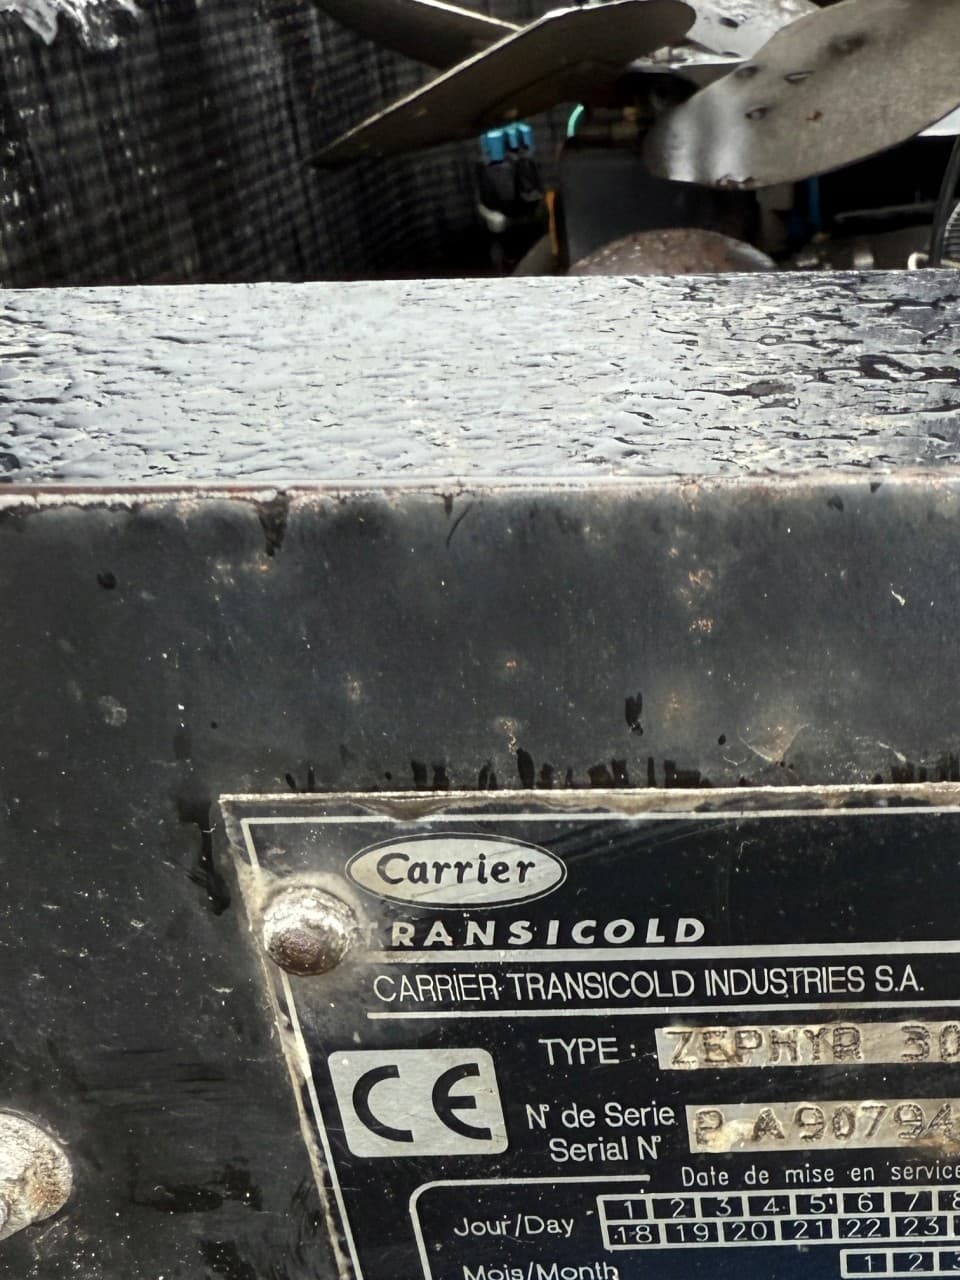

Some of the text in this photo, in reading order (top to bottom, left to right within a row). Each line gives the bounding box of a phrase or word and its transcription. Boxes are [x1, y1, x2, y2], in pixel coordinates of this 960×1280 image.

[376, 853, 535, 884] Carrier
[374, 965, 925, 1002] CARRIER TRANSICOLD INDUSTRIES S.A.
[664, 1024, 865, 1068] ZEPHYR
[352, 1063, 493, 1143] CE
[561, 1103, 596, 1128] de
[604, 1100, 675, 1128] Serie
[549, 1135, 629, 1163] Serial
[682, 1165, 729, 1187] Date
[744, 1165, 770, 1185] de
[785, 1163, 835, 1183] mise
[851, 1165, 875, 1181] en
[453, 1213, 575, 1238] Jour/Day
[615, 1223, 653, 1244] 18
[675, 1222, 710, 1243] 19
[731, 1221, 768, 1242] 20
[792, 1219, 826, 1240] 21
[845, 1217, 882, 1238] 22
[903, 1216, 940, 1237] 23
